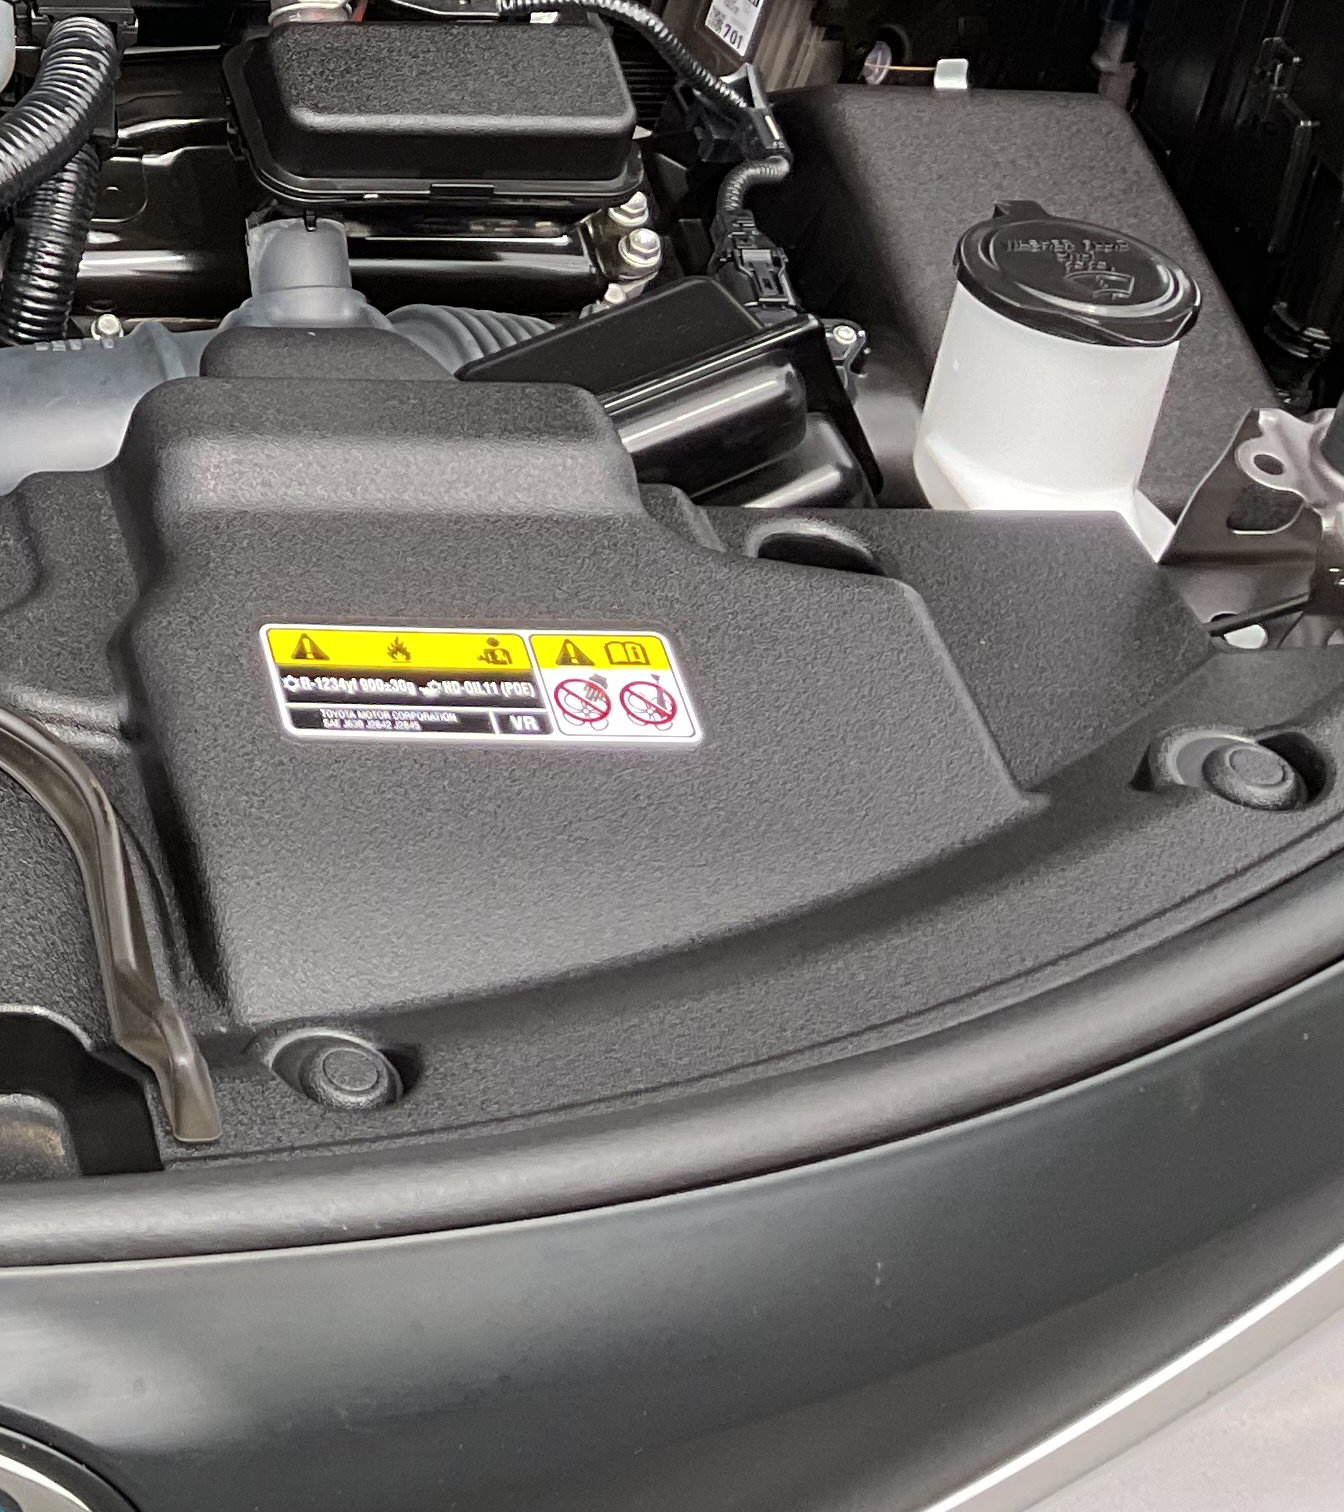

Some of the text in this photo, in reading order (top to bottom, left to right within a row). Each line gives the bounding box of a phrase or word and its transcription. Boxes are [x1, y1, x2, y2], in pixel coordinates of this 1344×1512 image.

[723, 23, 745, 50] 701
[500, 680, 536, 698] (POE)
[320, 708, 459, 723] TOYOTA MOTOR CORPORATION
[508, 714, 541, 732] VR
